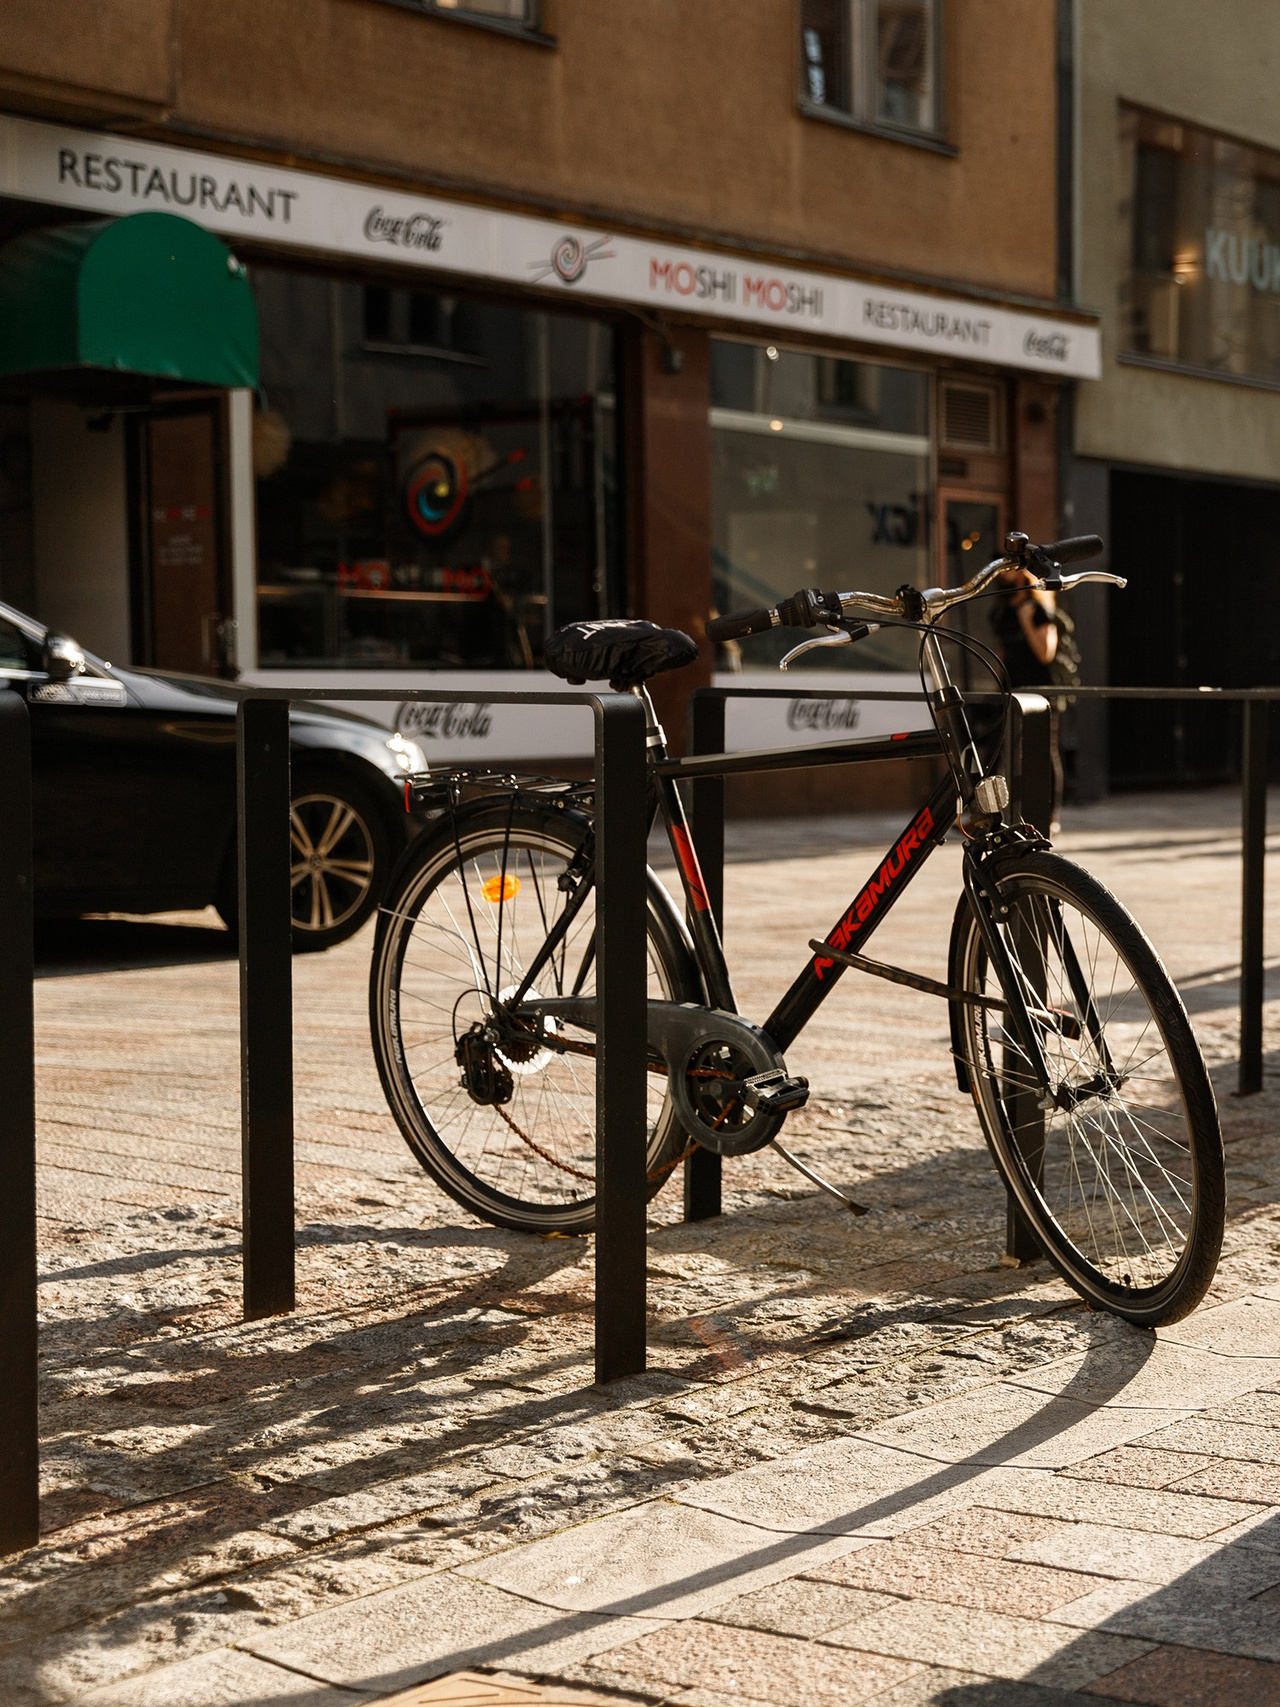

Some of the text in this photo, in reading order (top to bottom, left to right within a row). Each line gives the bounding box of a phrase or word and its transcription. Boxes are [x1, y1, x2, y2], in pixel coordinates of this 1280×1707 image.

[58, 148, 298, 223] RESTAURANT
[650, 257, 824, 319] MOSHI MOSHI
[862, 299, 992, 346] RESTAURANT
